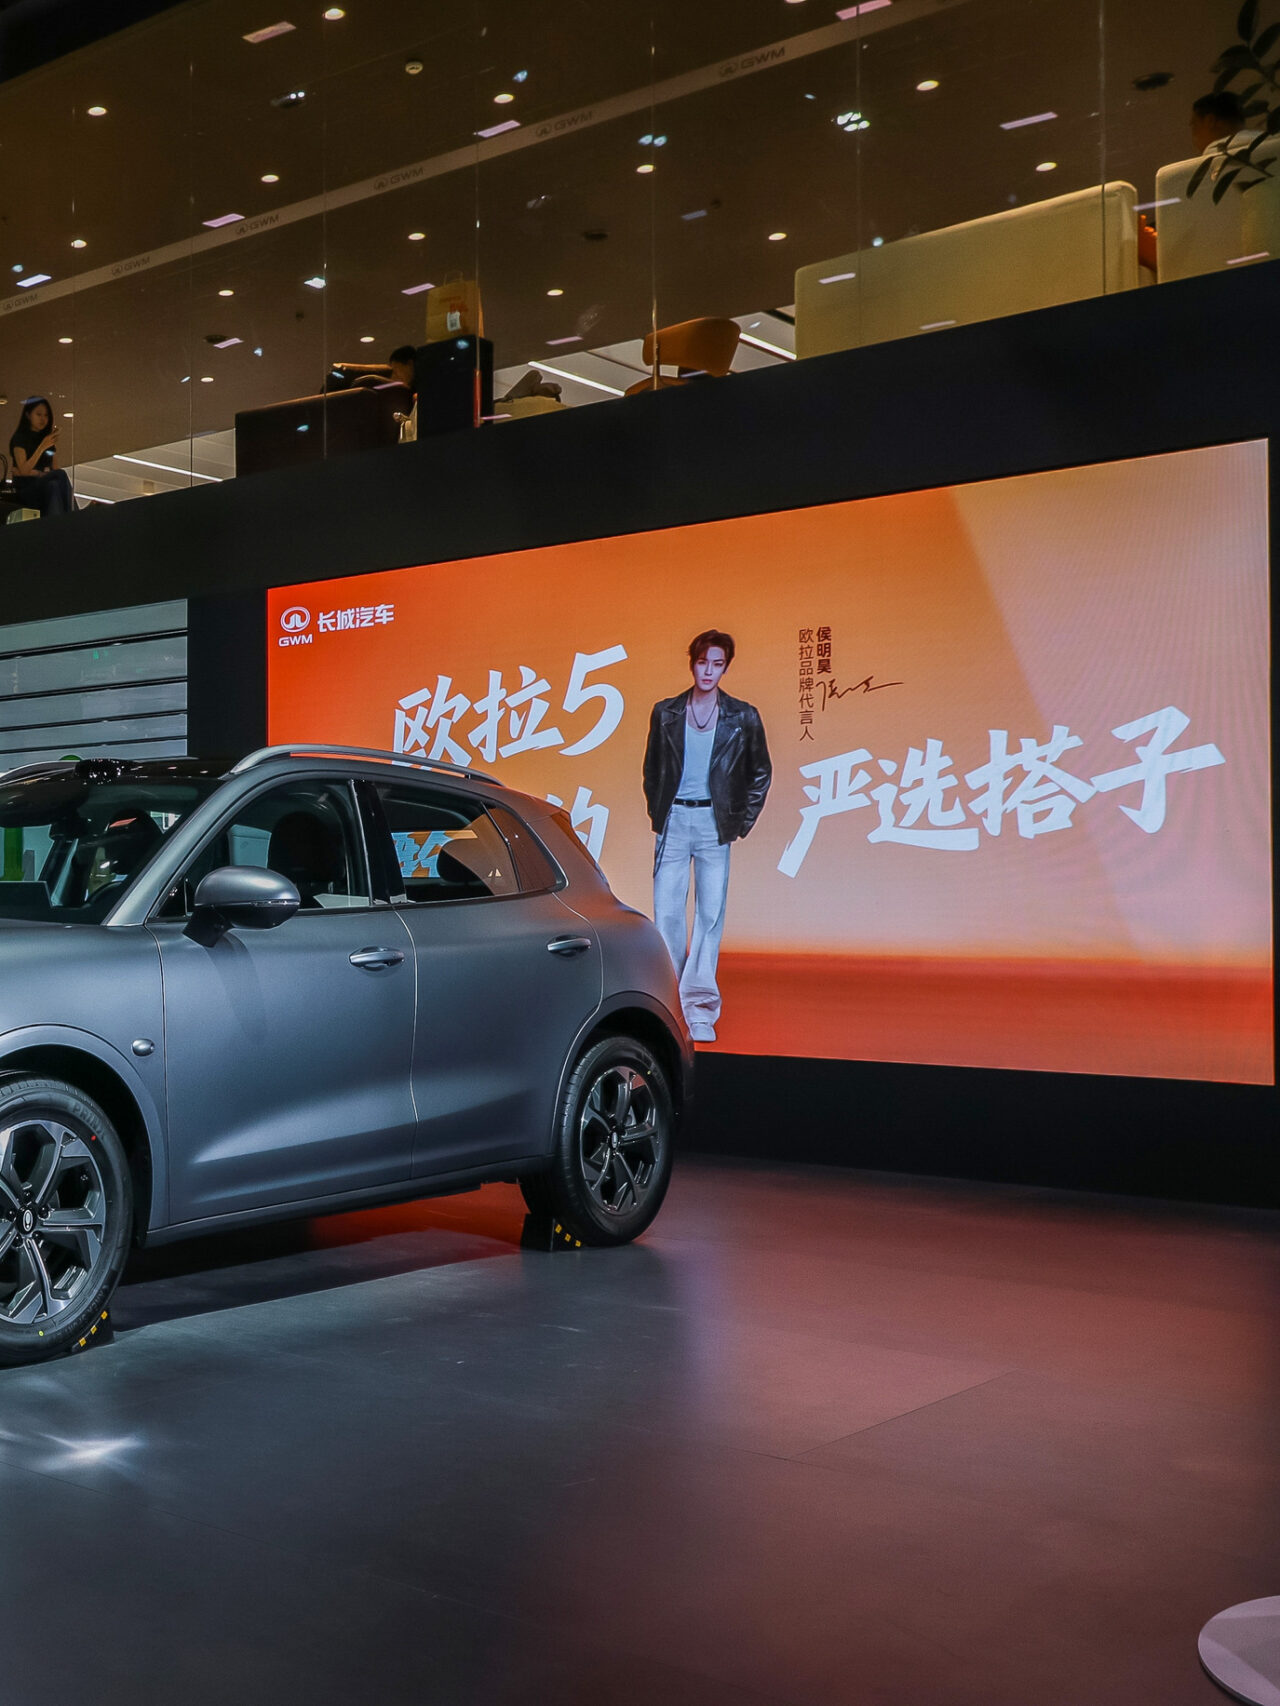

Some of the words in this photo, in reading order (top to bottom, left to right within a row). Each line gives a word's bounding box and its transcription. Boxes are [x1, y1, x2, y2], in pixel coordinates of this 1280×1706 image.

[740, 47, 786, 69] GWM
[278, 633, 313, 647] GWM
[317, 603, 395, 633] 长城汽车
[816, 626, 832, 674] 侯明昊
[392, 644, 628, 770] 欧拉5
[798, 628, 814, 742] 欧拉品牌代言人
[776, 705, 1226, 878] 严选搭子
